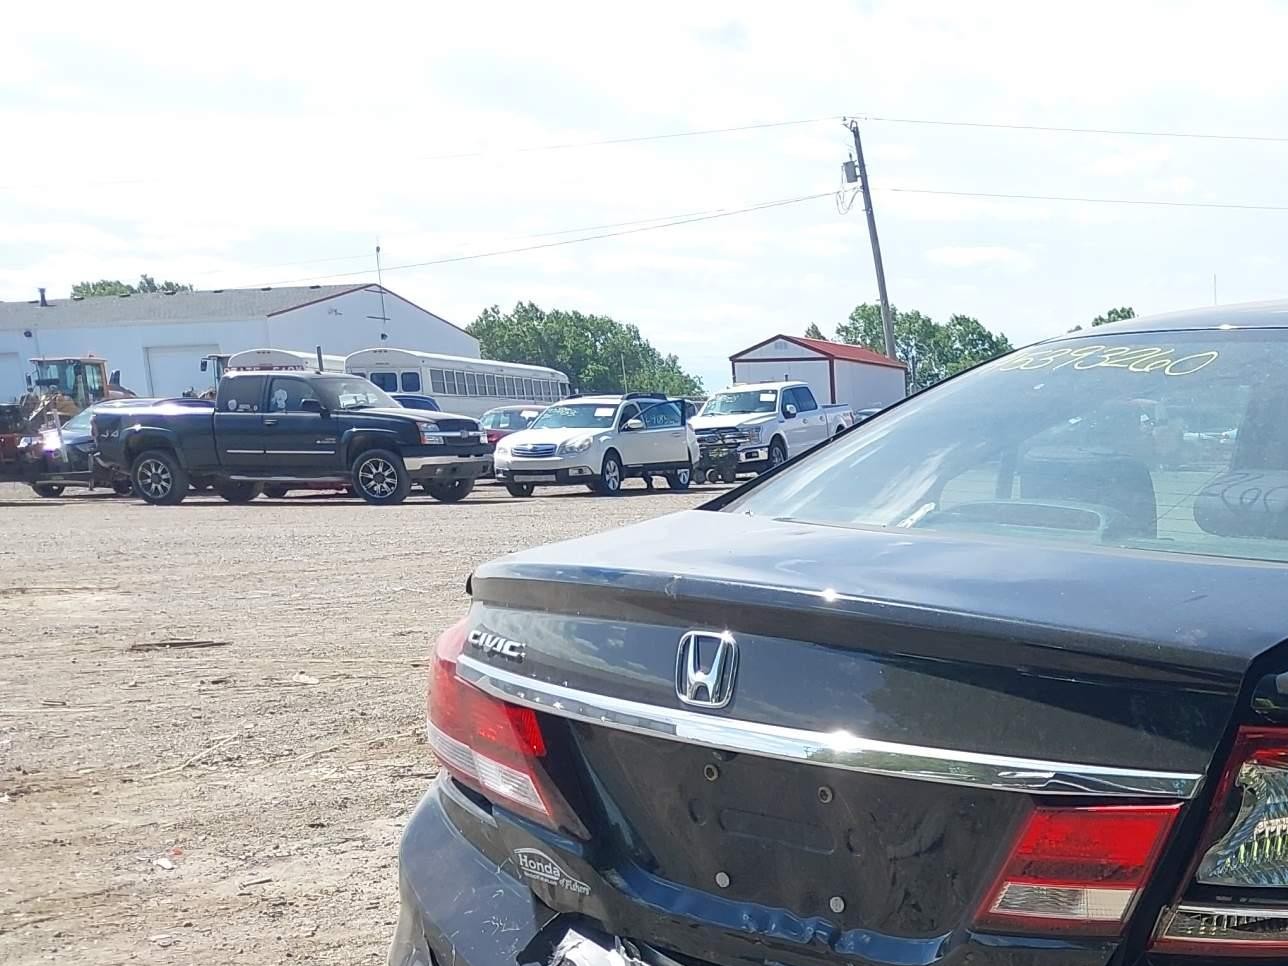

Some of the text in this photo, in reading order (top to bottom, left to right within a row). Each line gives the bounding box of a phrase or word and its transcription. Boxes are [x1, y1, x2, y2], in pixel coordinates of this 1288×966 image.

[1000, 345, 1219, 376] 5393260
[468, 630, 526, 657] CIVIC
[519, 853, 560, 878] Honda
